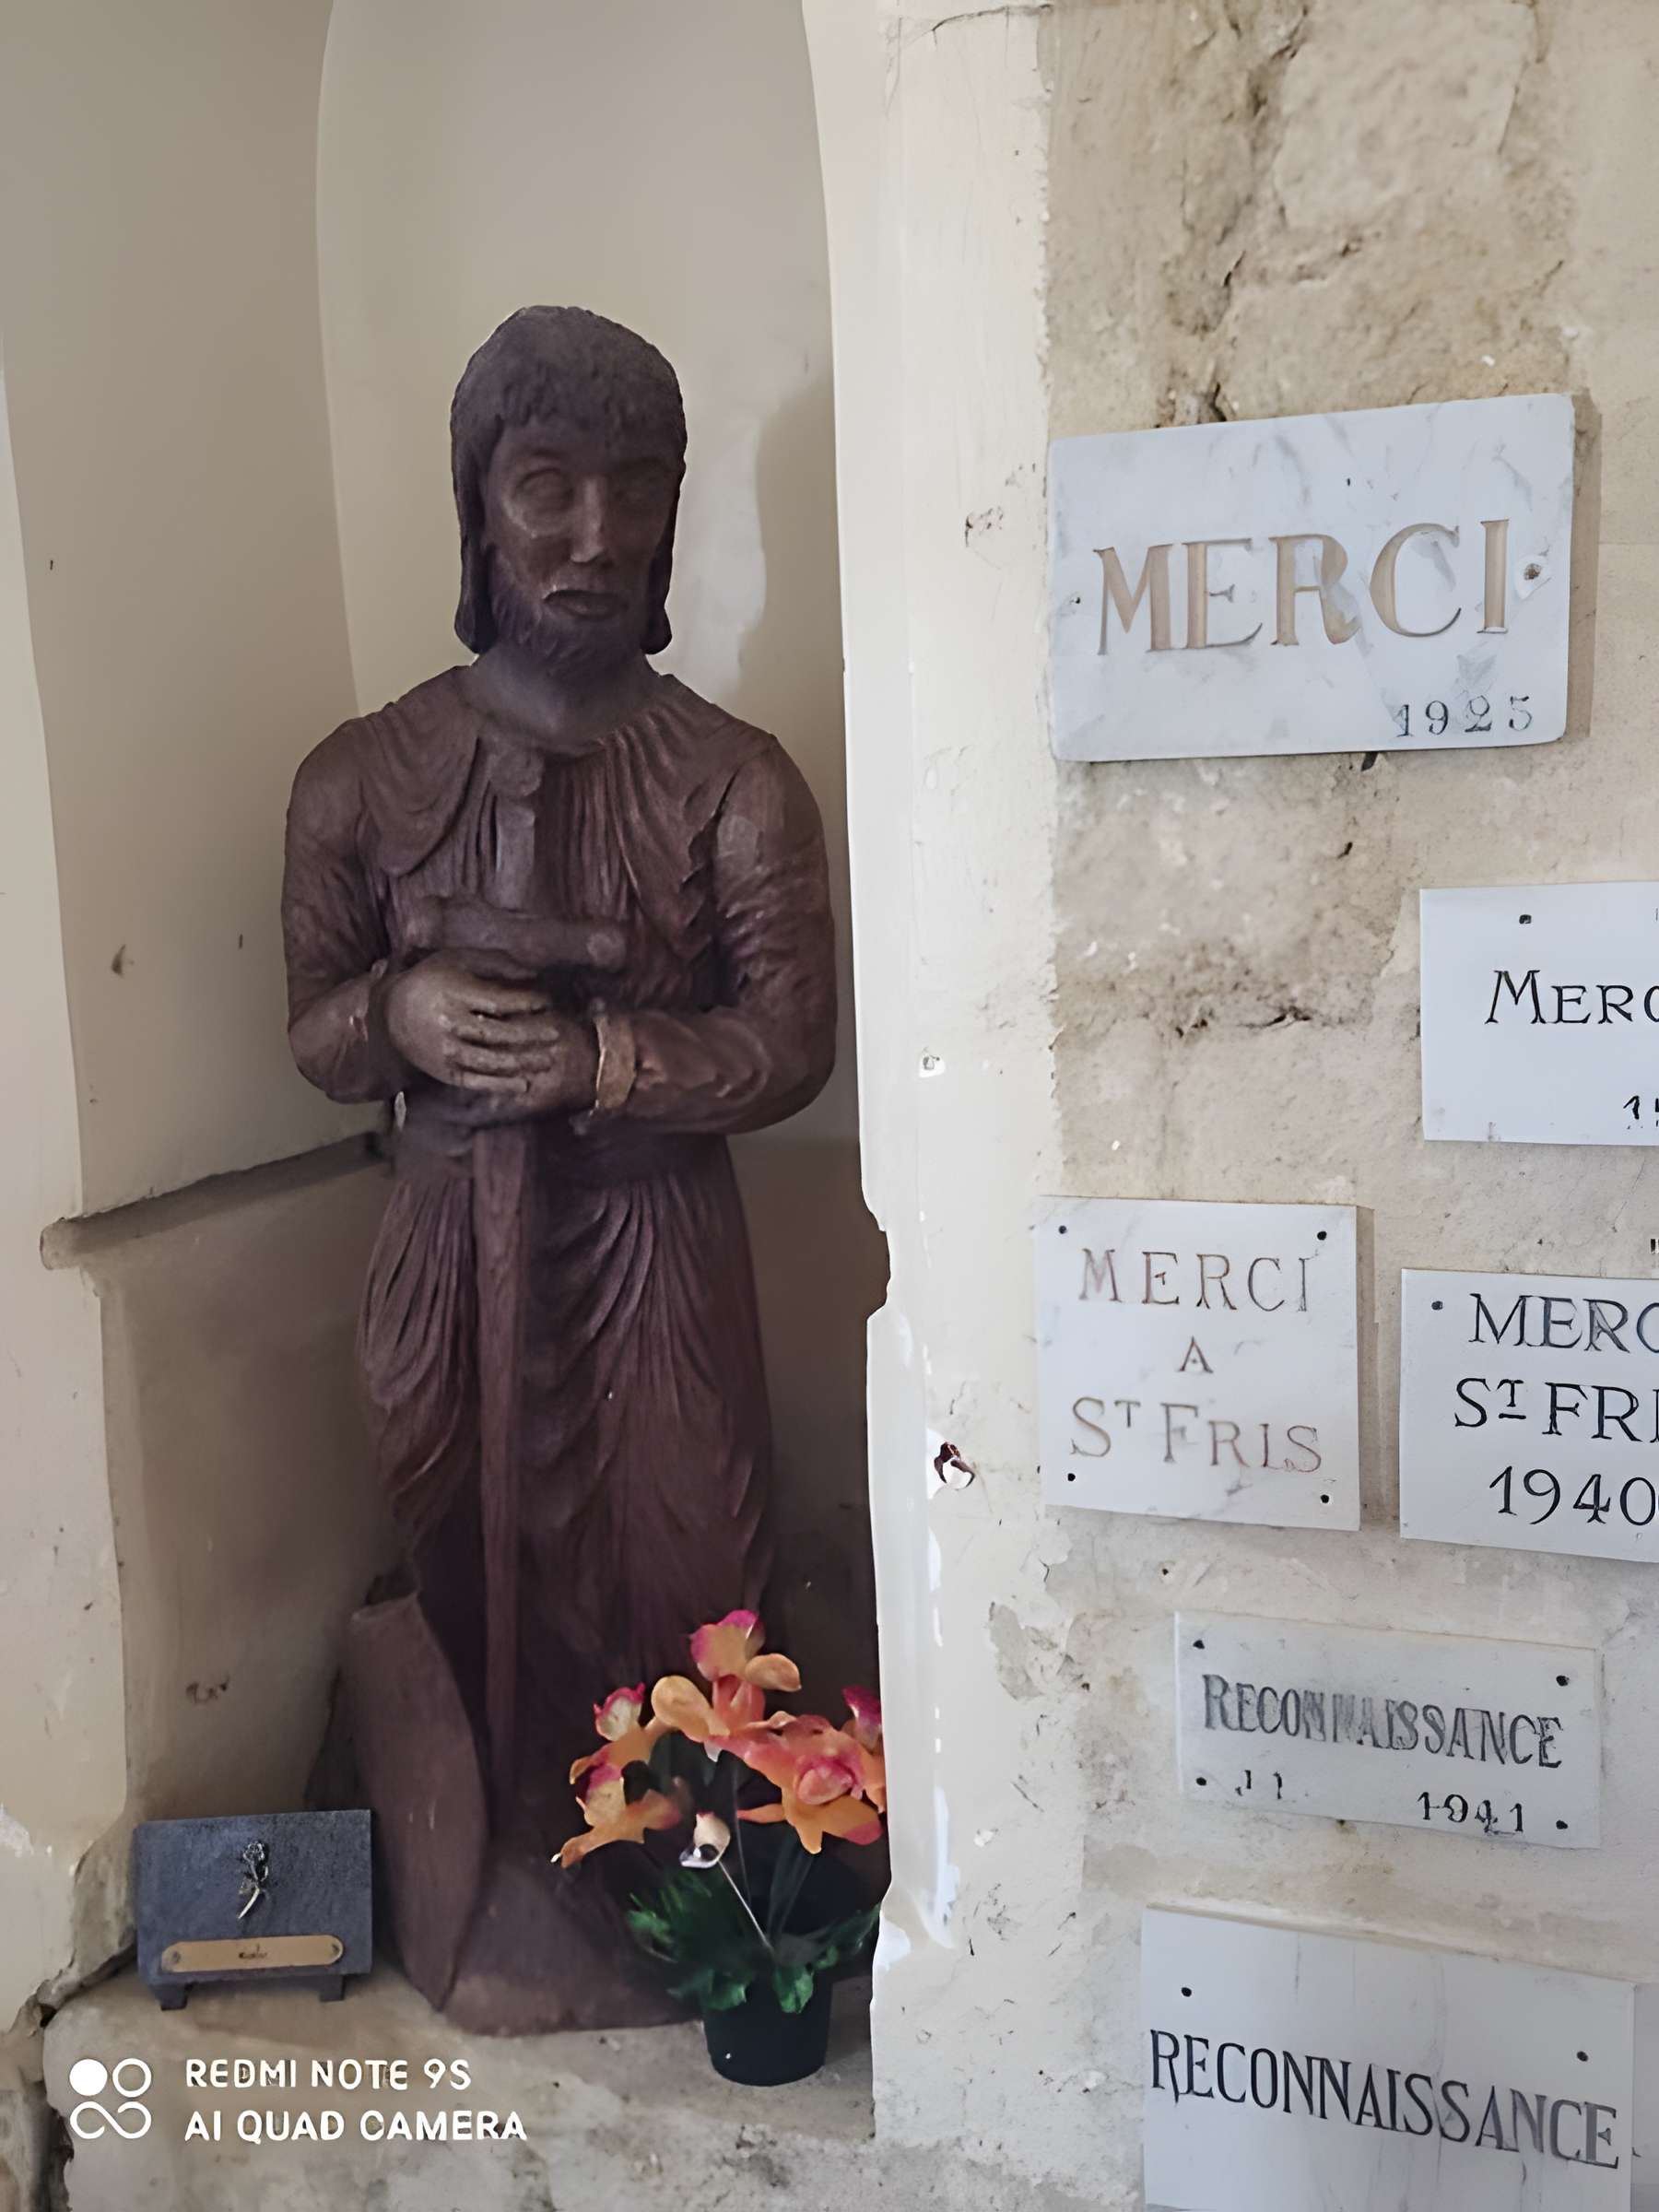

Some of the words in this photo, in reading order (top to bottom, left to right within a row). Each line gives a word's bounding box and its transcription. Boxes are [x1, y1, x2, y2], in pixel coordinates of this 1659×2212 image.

[1092, 518, 1512, 655] MERCI
[1394, 695, 1534, 737] 1925
[1078, 1247, 1312, 1312] MERCI
[1176, 1335, 1214, 1374] A
[1159, 1402, 1323, 1473] FRIS
[1488, 1465, 1658, 1527] 1940
[1202, 1673, 1563, 1770] RECONNAISSANCE
[1149, 2028, 1620, 2171] RECONNAISSANCE
